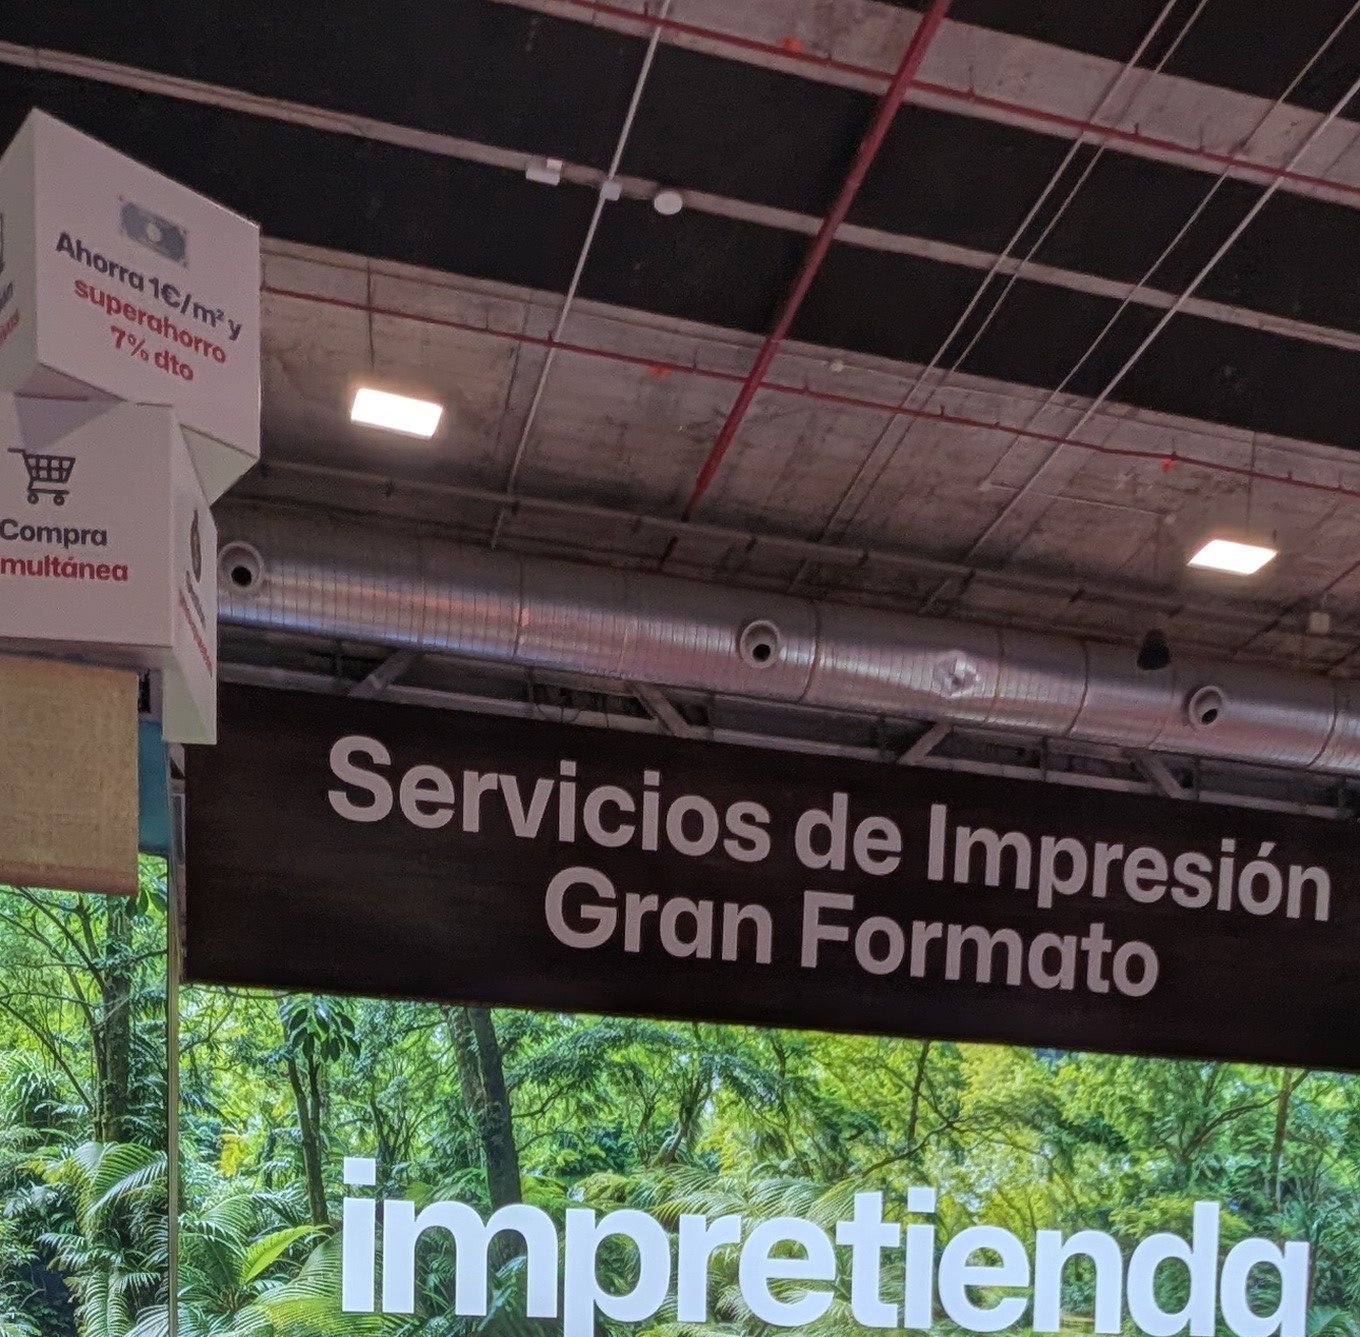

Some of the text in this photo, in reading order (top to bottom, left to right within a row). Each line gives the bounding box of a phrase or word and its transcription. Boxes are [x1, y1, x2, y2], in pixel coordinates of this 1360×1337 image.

[55, 231, 145, 292] Ahorra
[74, 278, 227, 364] superahorro
[111, 326, 195, 382] 7% dto
[327, 734, 1331, 922] Servicios de Impresión
[544, 866, 1160, 997] Gran Formato
